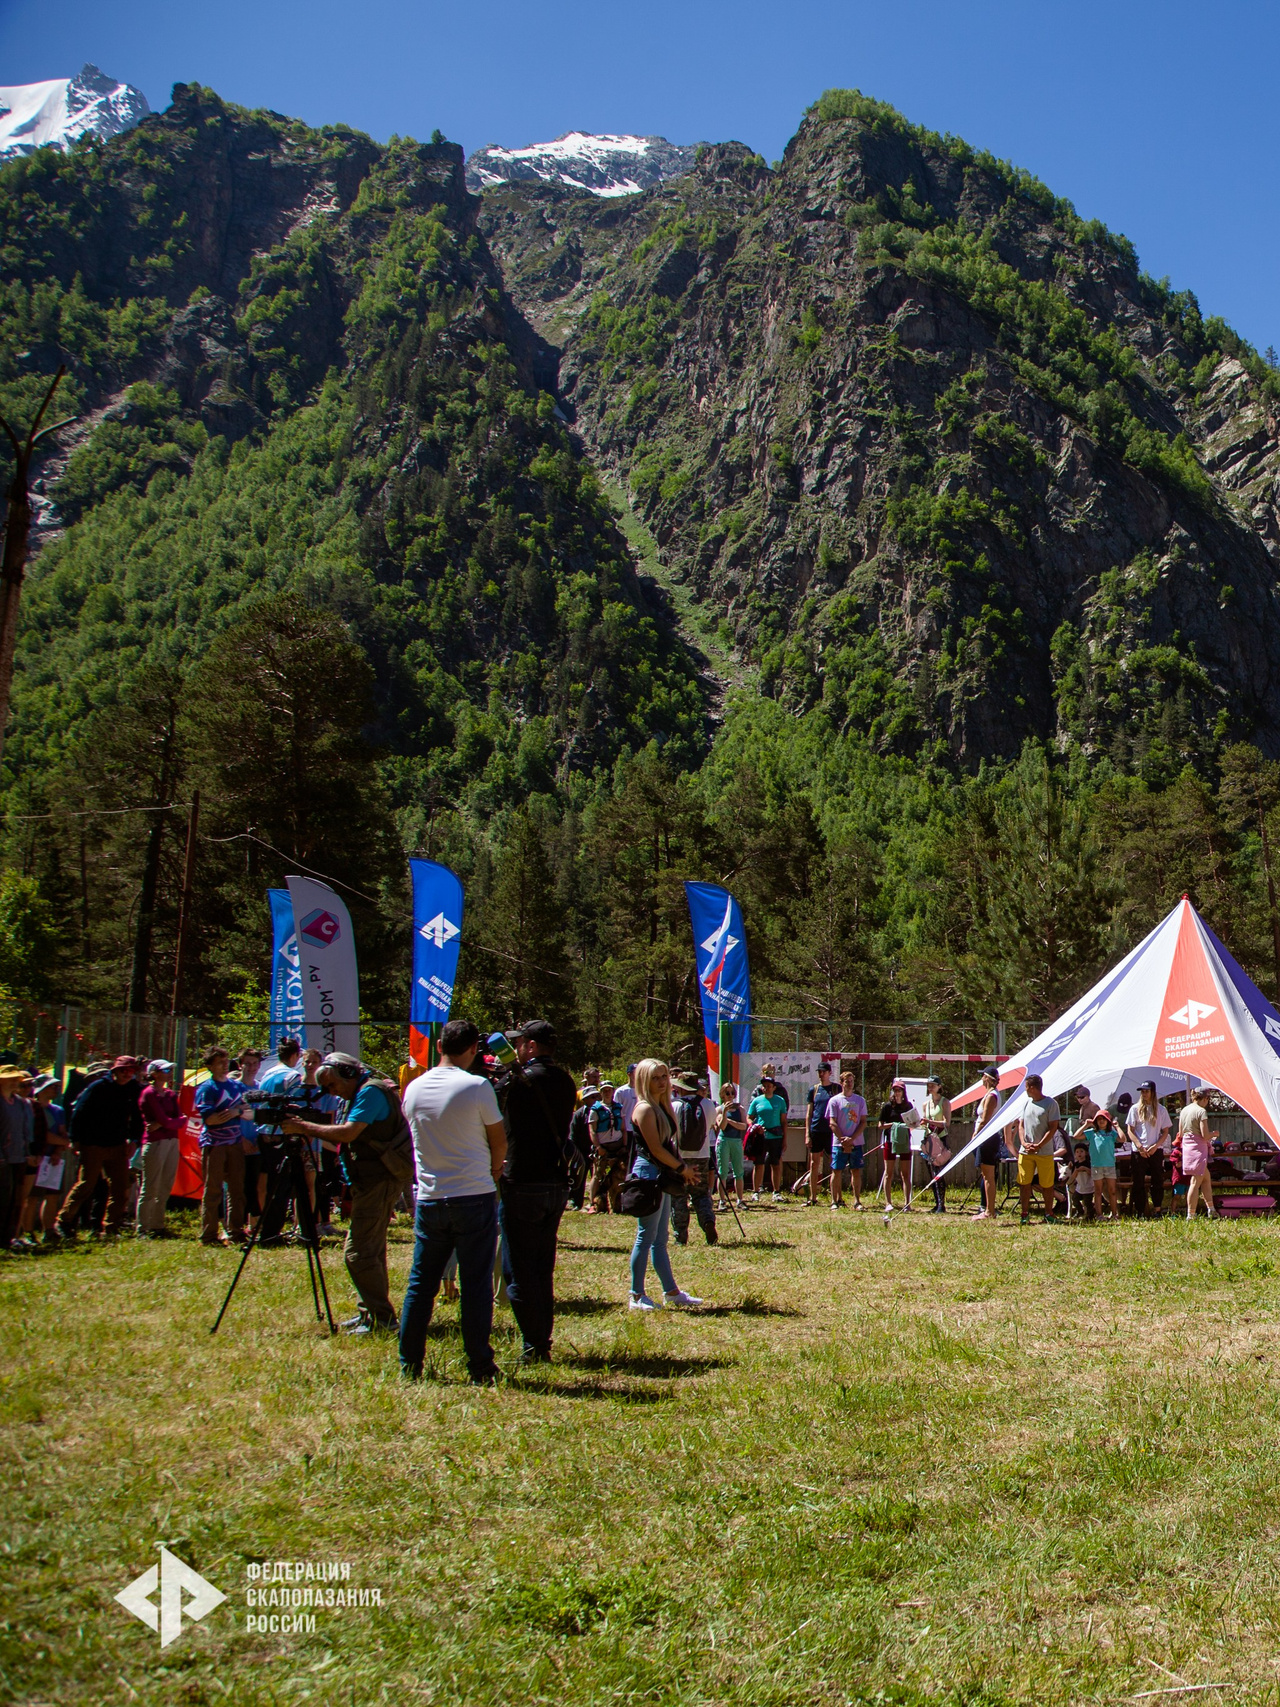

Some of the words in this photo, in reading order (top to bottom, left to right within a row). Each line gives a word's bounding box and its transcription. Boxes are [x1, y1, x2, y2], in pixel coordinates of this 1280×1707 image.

[1164, 1030, 1211, 1045] ФЕДЕРАЦИЯ
[1164, 1035, 1225, 1052] СКАЛОЛАЗАНИЯ
[1165, 1049, 1197, 1059] РОССИИ
